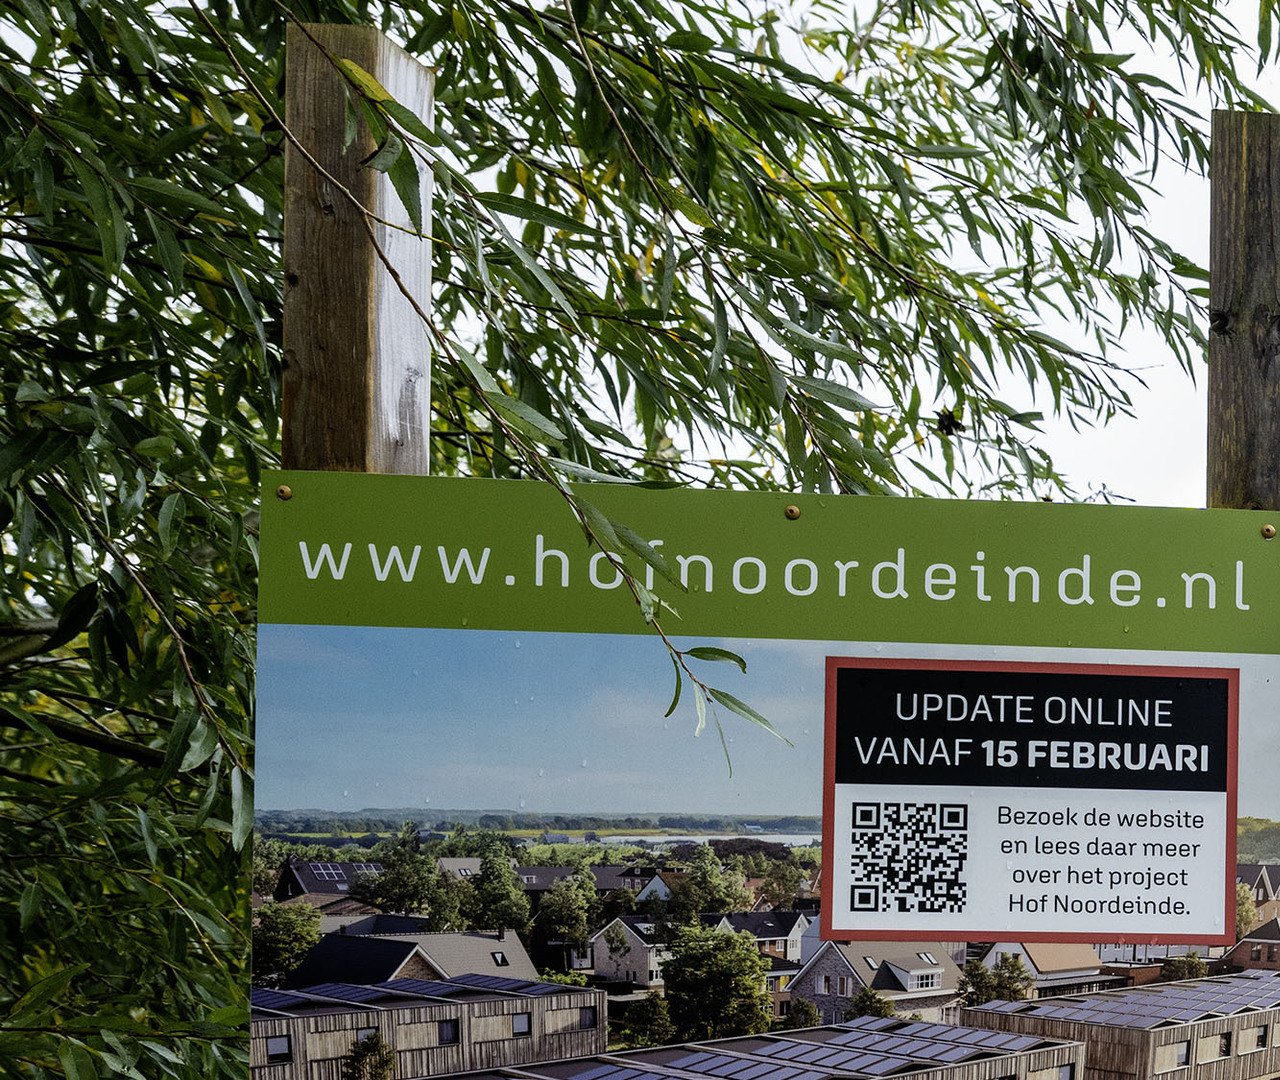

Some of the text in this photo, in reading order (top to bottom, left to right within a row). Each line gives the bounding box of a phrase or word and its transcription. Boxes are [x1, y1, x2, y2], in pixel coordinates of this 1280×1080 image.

[299, 533, 1250, 611] www.hofnoordeinde.nl
[896, 693, 1173, 727] UPDATE ONLINE
[854, 736, 1209, 772] VANAF 15 FEBRUARI
[997, 805, 1205, 829] Bezoek de website
[1000, 835, 1201, 858] en lees daar meer
[1012, 865, 1189, 890] over het project
[1009, 893, 1191, 915] Hof Noordeinde.
